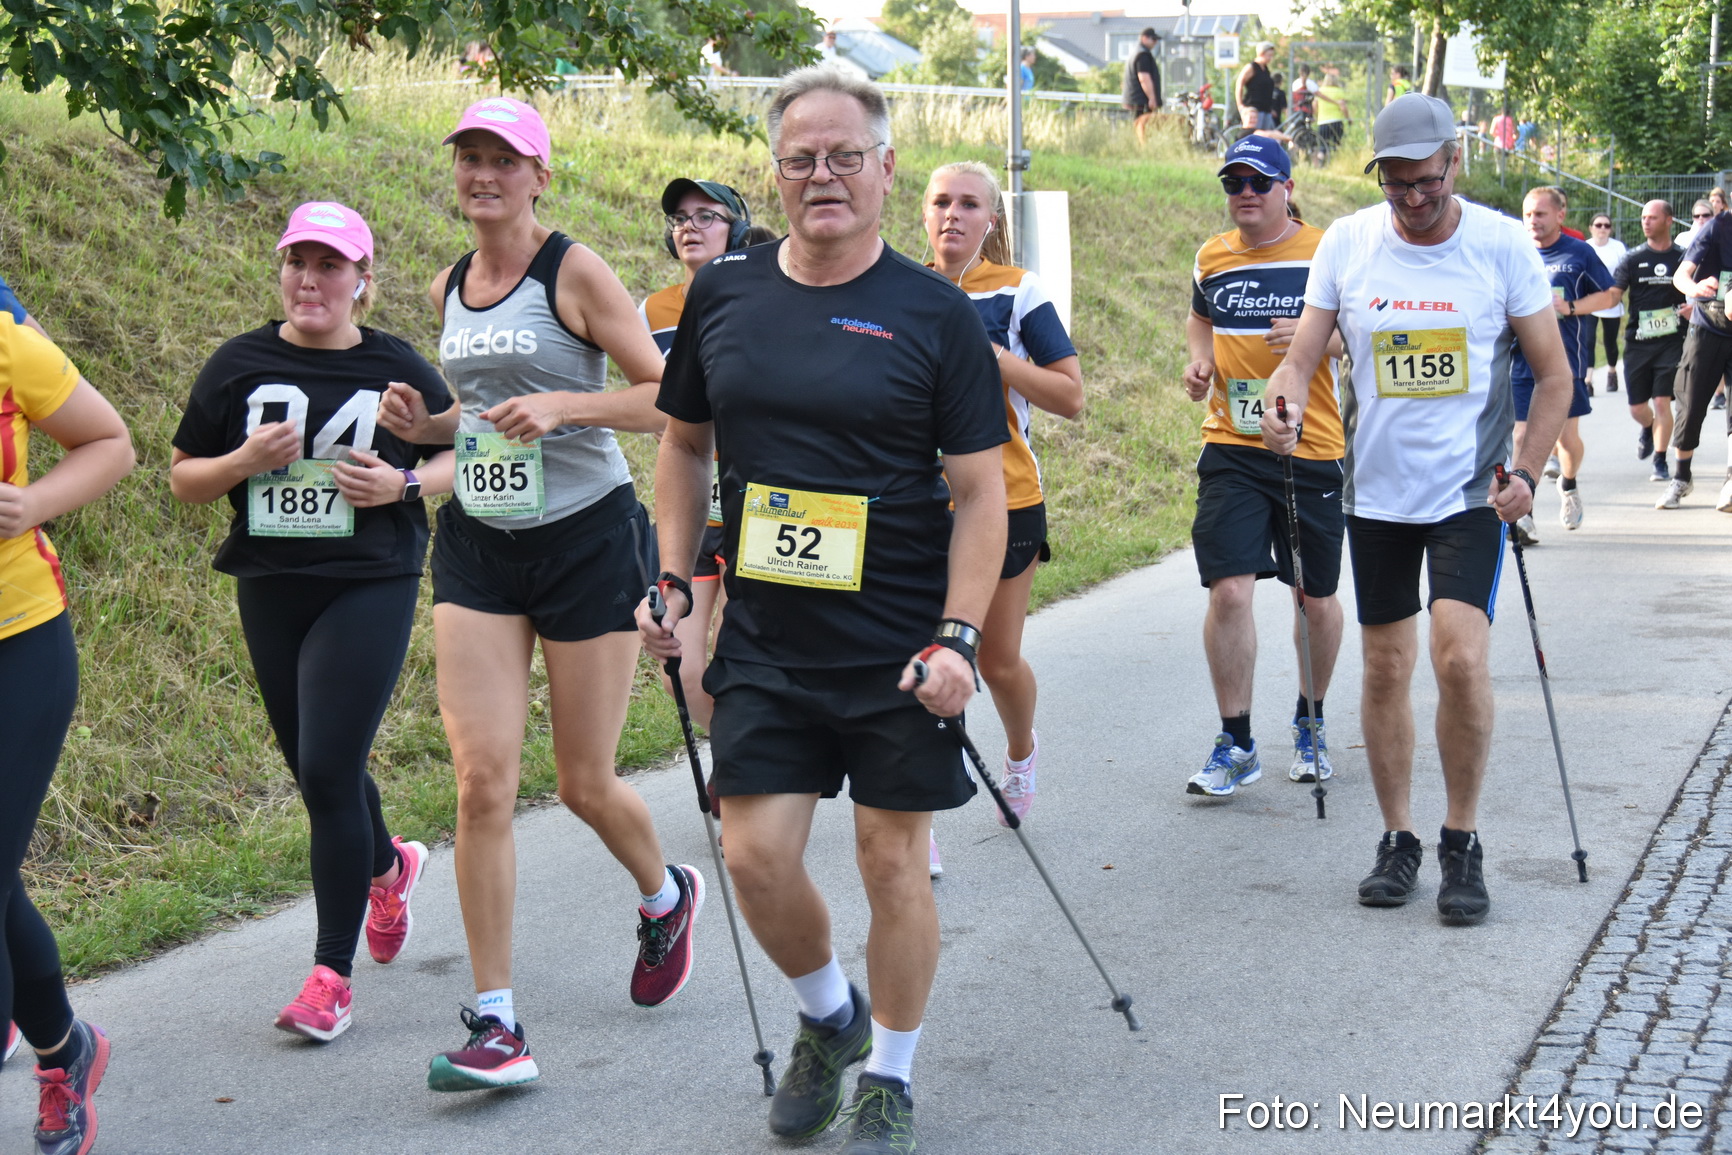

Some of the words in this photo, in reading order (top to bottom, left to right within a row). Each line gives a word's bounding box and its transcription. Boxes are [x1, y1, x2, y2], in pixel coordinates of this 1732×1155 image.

[723, 254, 747, 262] JAKO
[1226, 293, 1304, 309] Fischer
[1392, 300, 1458, 312] KLEBL
[1234, 309, 1297, 317] AUTOMOBILE
[830, 316, 883, 332] autoladen
[842, 323, 894, 340] neumarkt
[1386, 353, 1455, 379] 1158
[1416, 378, 1450, 387] Bernhard
[463, 462, 528, 493] 1885
[262, 487, 340, 515] 1887
[493, 493, 515, 501] Karin
[759, 504, 807, 519] firmenlauf
[834, 520, 858, 529] 2019
[775, 523, 822, 561] 52
[743, 562, 770, 572] Autoladen
[777, 568, 805, 577] Neumarkt
[767, 556, 794, 569] Ulrich
[796, 560, 829, 572] Rainer
